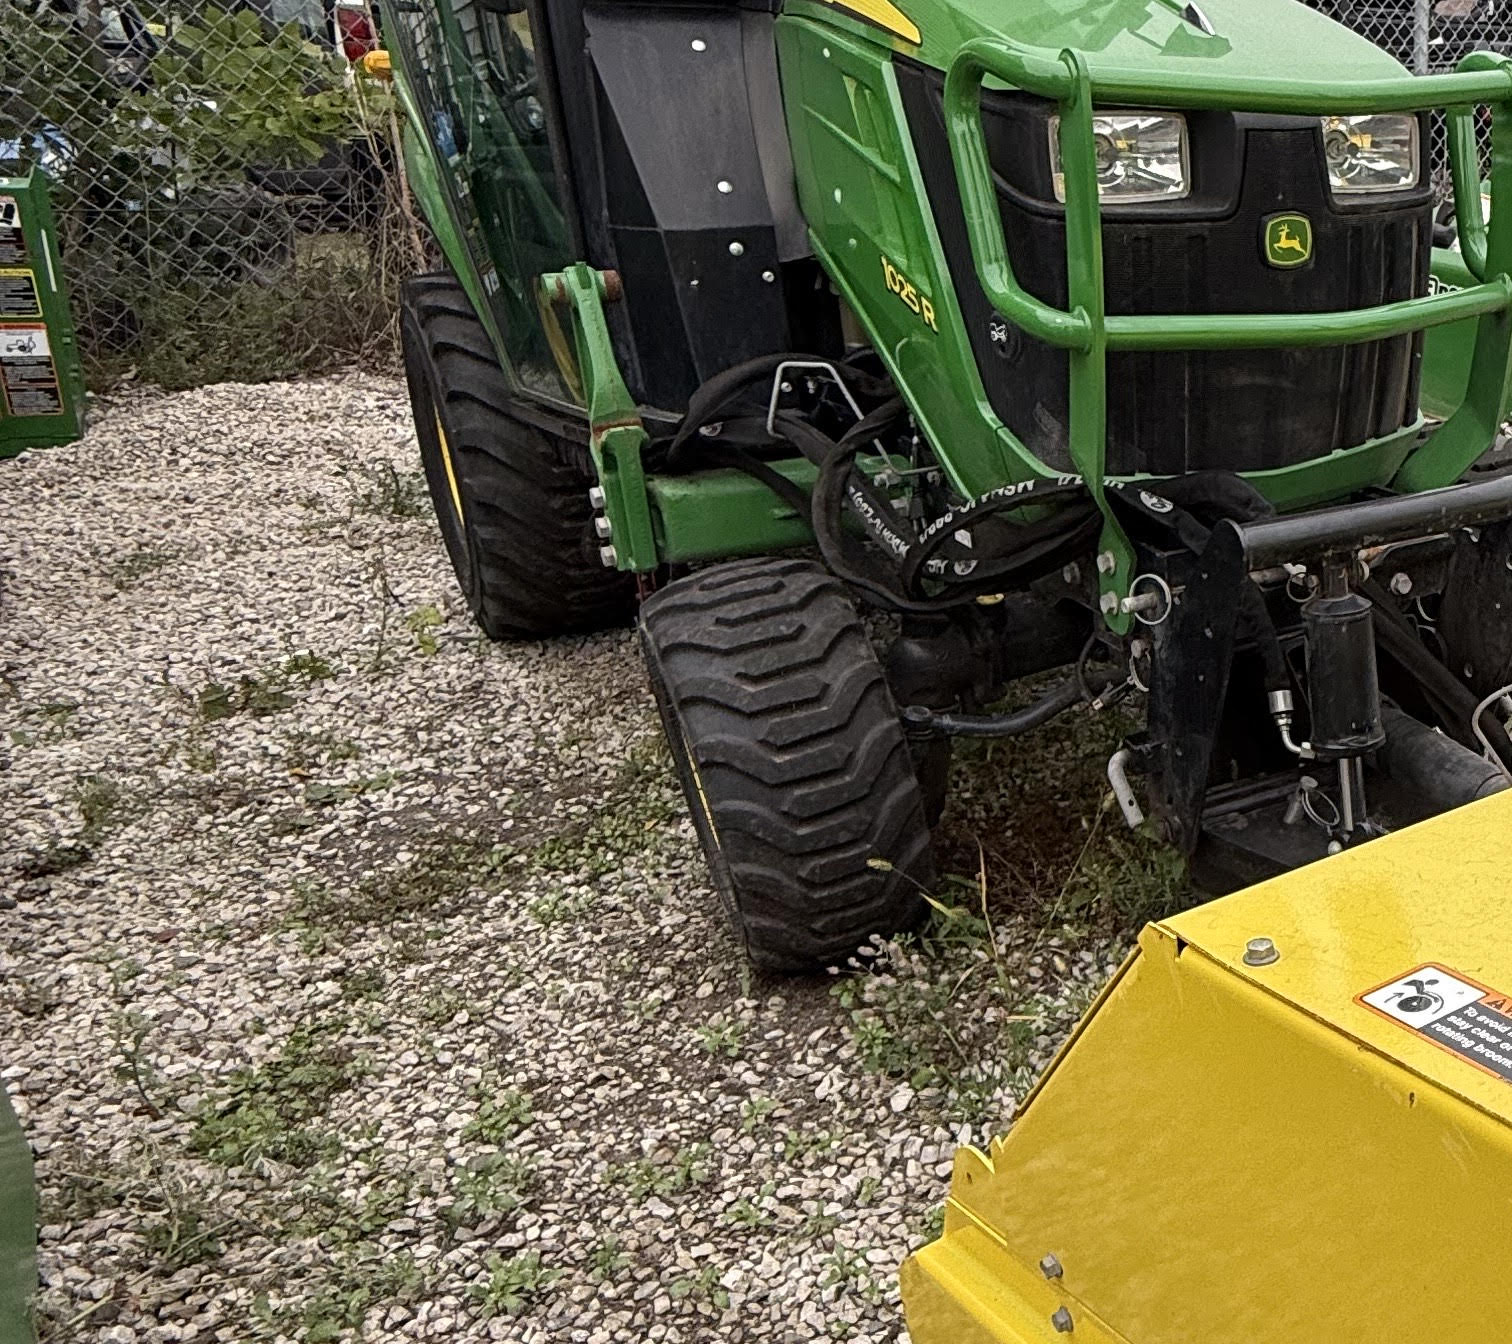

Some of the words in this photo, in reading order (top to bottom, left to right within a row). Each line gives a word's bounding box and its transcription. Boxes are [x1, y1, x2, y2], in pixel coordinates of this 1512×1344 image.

[1447, 1015, 1473, 1030] stay
[1471, 1027, 1502, 1043] clear
[1463, 1006, 1478, 1017] To
[1476, 1015, 1512, 1033] avoid
[1431, 1022, 1475, 1048] rotating
[1473, 1043, 1512, 1068] broom.
